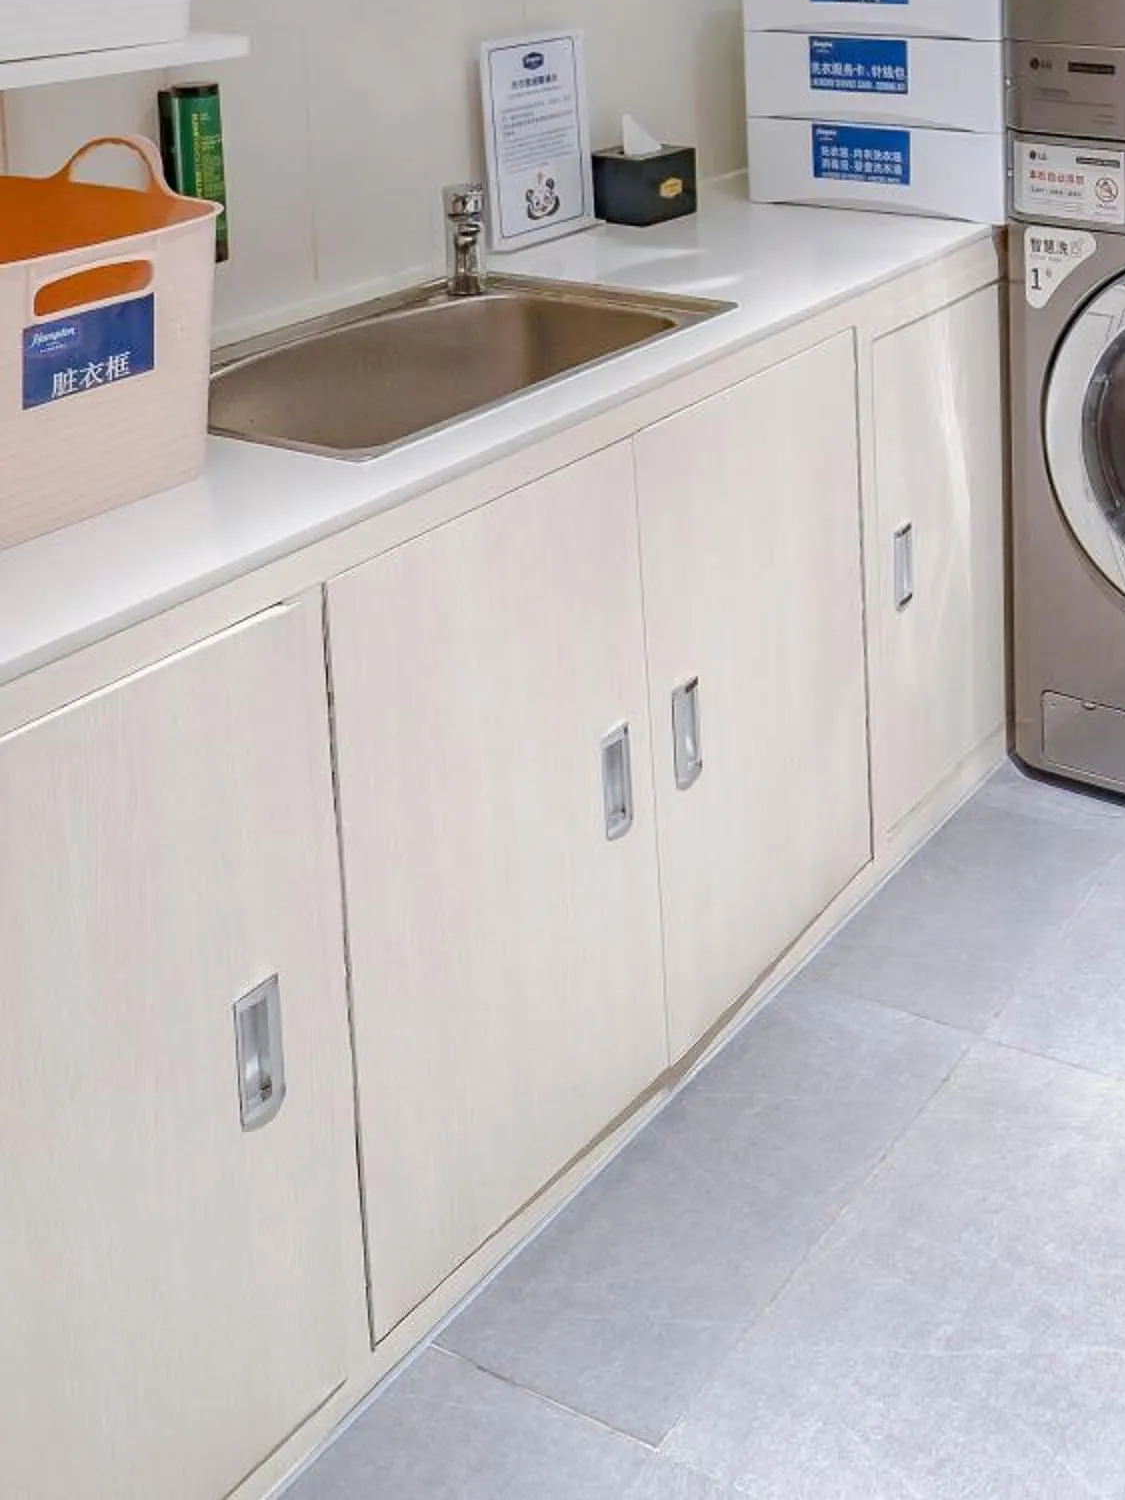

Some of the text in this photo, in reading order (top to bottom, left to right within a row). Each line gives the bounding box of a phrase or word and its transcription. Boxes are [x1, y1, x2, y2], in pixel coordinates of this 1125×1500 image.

[1030, 237, 1070, 256] 智慧洗
[30, 327, 76, 349] Hampton
[51, 351, 131, 399] 脏衣框
